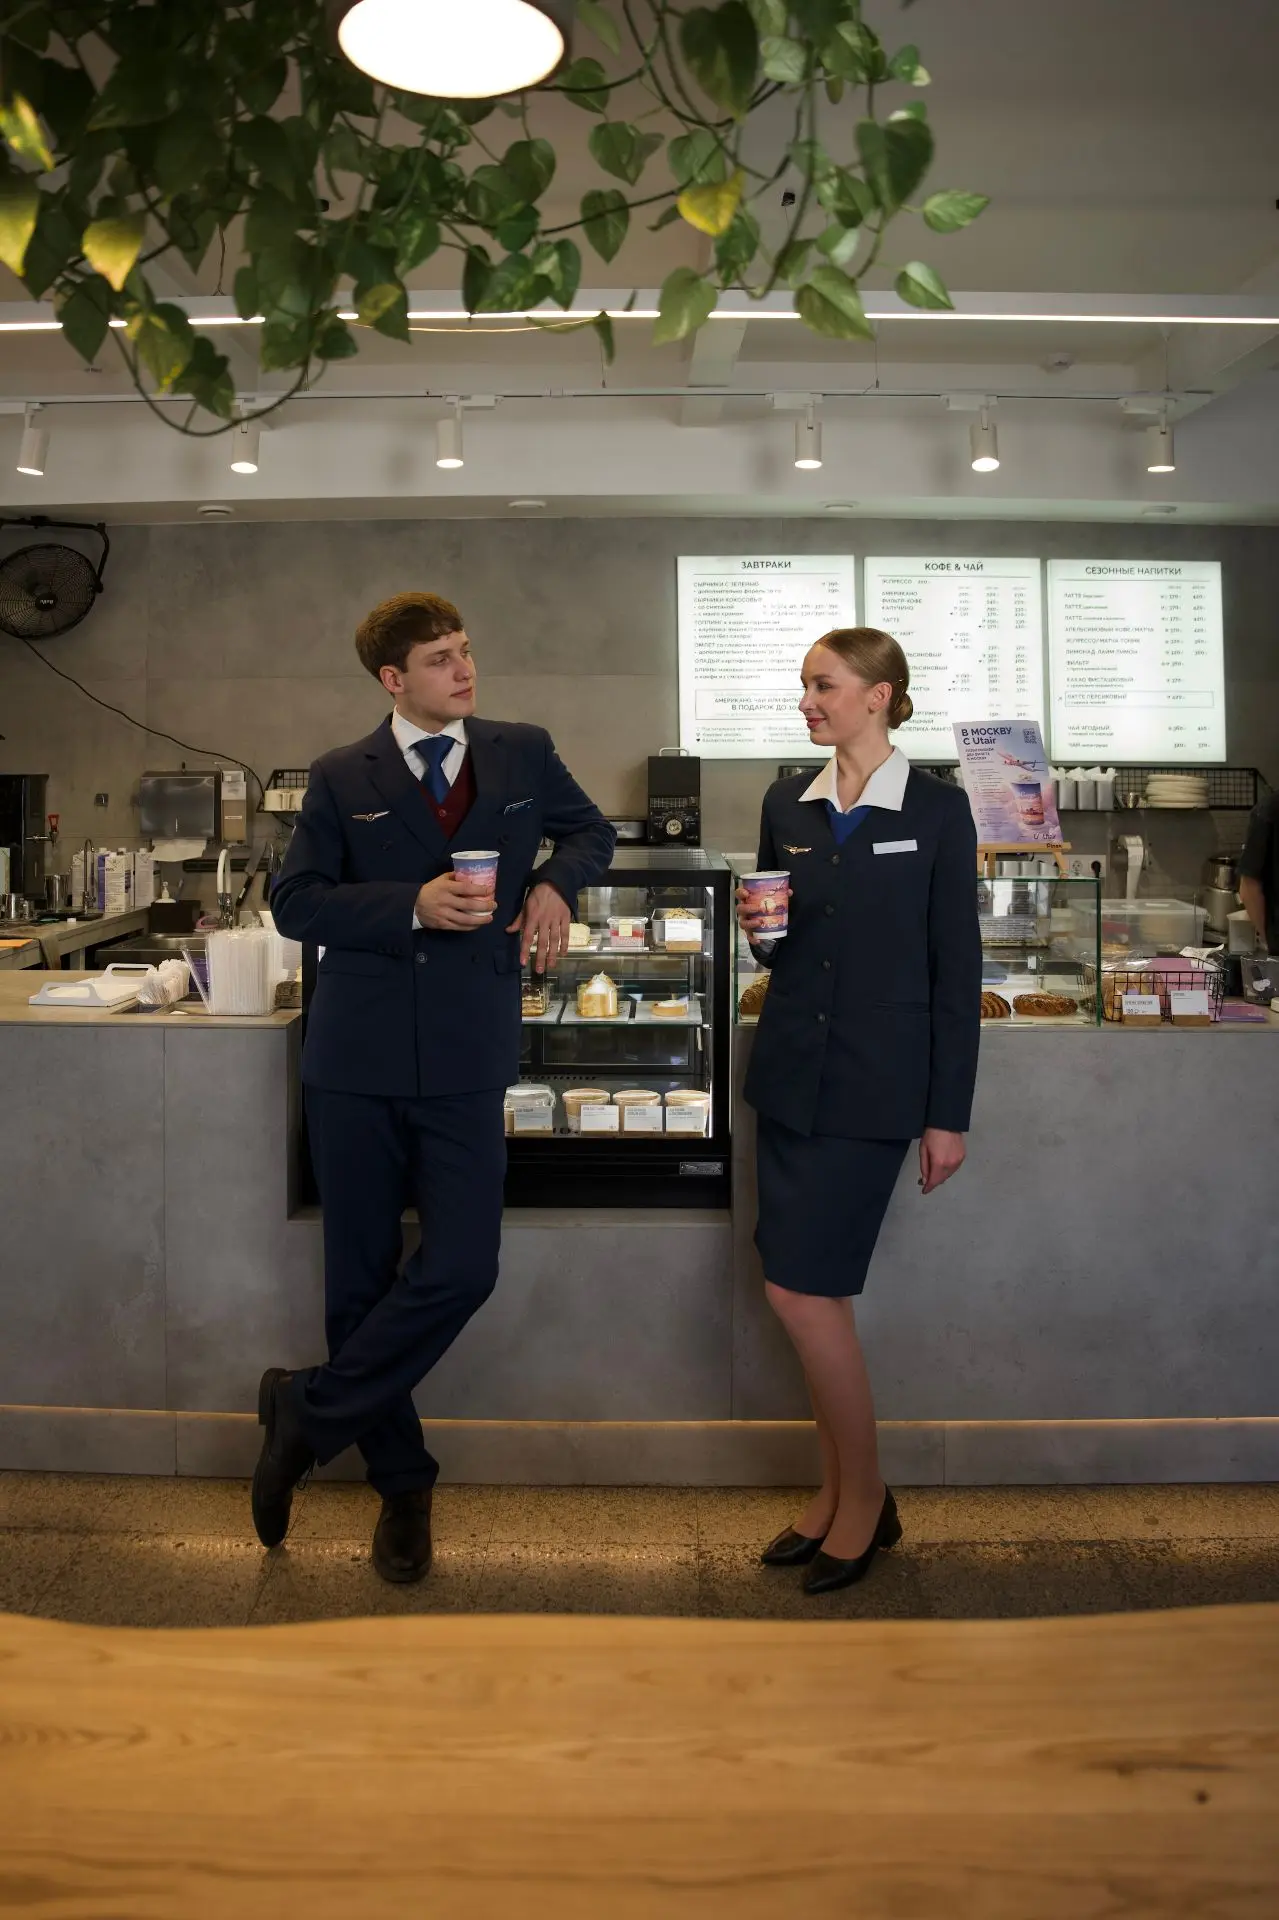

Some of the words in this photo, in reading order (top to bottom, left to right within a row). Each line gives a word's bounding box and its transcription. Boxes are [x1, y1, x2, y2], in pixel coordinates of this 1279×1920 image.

[741, 561, 791, 569] ЗАВТРАКИ
[924, 562, 951, 571] КОФЕ
[954, 563, 960, 571] &
[964, 562, 984, 571] ЧАЙ
[1085, 566, 1135, 575] СЕЗОННЫЕ
[1138, 567, 1182, 575] НАПИТКИ
[961, 728, 968, 736] В
[971, 726, 1012, 736] МОСКВУ
[973, 736, 996, 745] Utair
